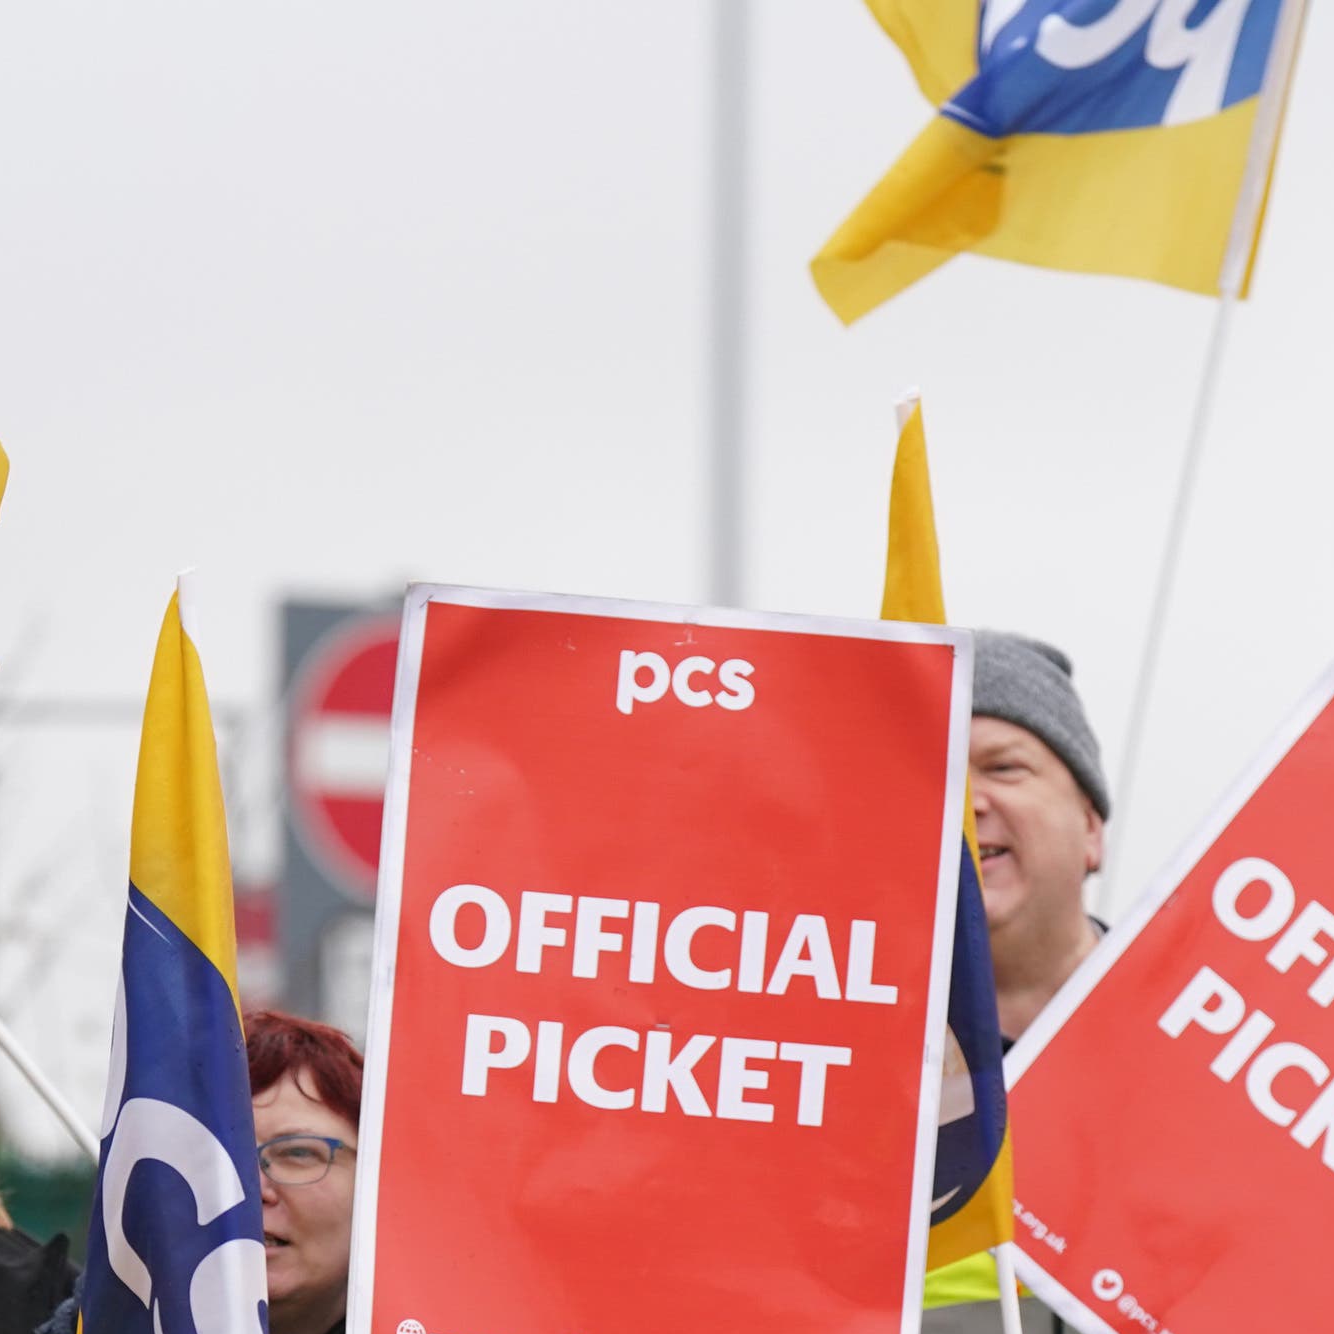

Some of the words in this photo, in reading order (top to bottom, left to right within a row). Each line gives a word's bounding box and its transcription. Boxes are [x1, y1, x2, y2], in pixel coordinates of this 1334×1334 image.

[616, 648, 756, 715] pcs
[428, 883, 898, 1006] OFFICIAL
[460, 1012, 852, 1127] PICKET
